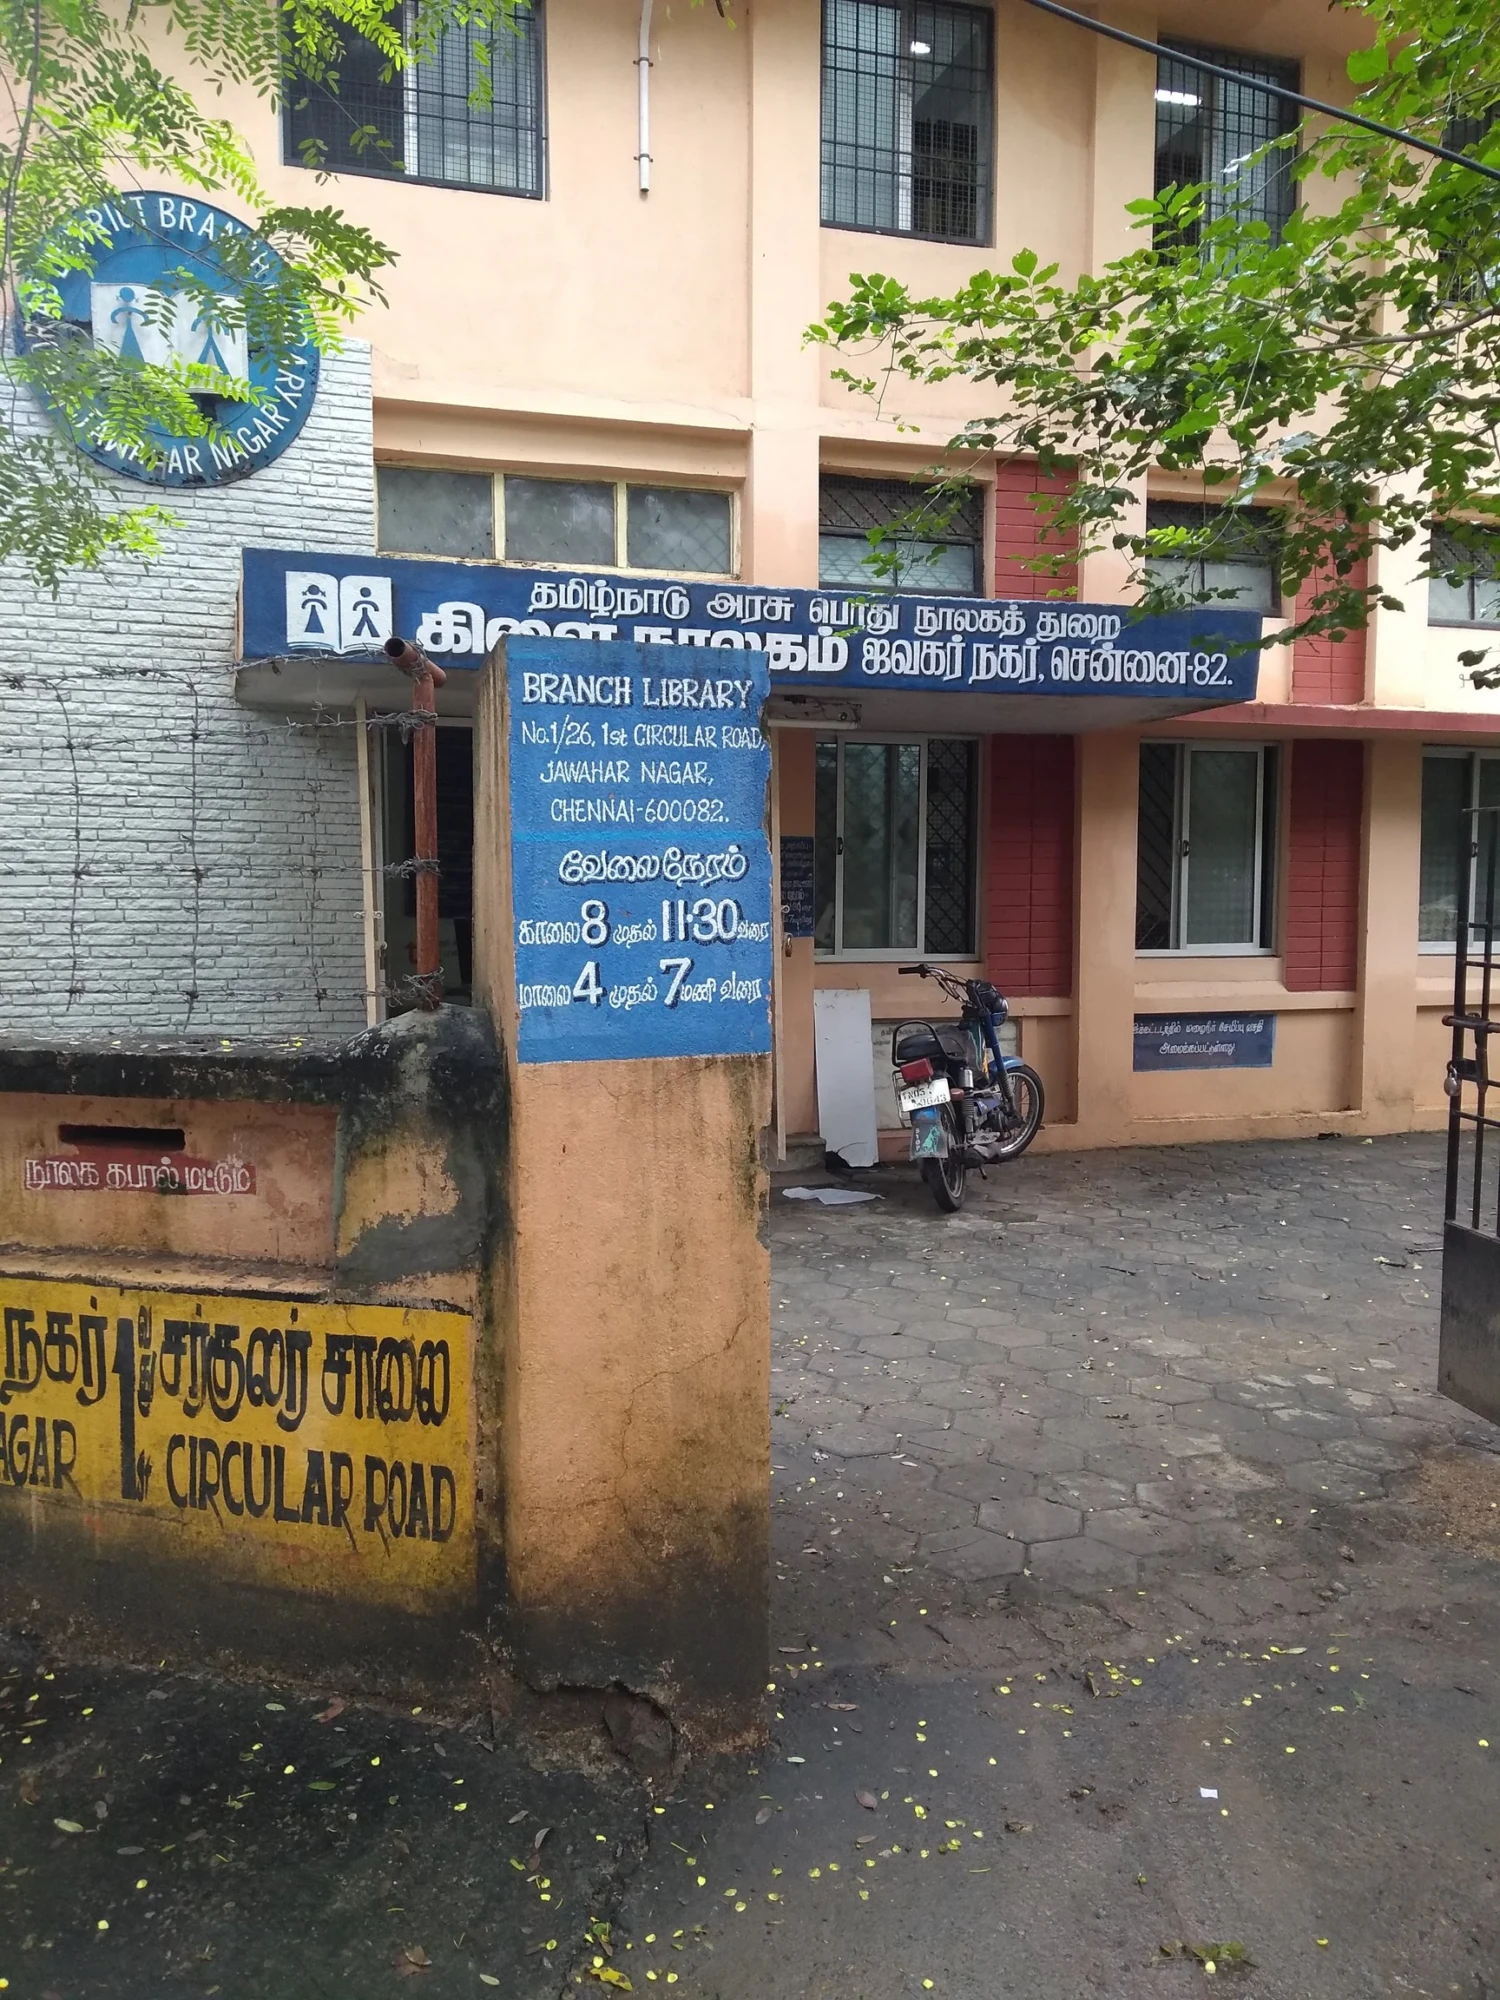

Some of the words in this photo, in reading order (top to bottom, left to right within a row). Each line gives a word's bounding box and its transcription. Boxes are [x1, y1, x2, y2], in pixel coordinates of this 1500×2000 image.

[209, 403, 291, 471] NAGAR
[528, 577, 691, 620] தமிழ்நாடு
[706, 592, 796, 625] அரசு
[808, 598, 901, 637] பொது
[915, 604, 1026, 639] நூலகத்
[1037, 610, 1122, 645] துறை
[862, 635, 964, 681] ஜவகர்
[969, 637, 1045, 684] நகர்,
[522, 672, 631, 705] BRANCH
[643, 677, 754, 708] LIBRARY
[601, 721, 628, 746] 1st
[633, 723, 717, 748] CIRCULAR
[721, 726, 766, 751] ROAD,
[540, 760, 630, 784] JAWAHAR
[640, 760, 714, 786] NAGAR,
[518, 919, 581, 946] காலை
[581, 899, 609, 946] 8
[612, 918, 658, 949] முதல்
[737, 919, 770, 942] வரை
[518, 983, 572, 1009] மாலை
[572, 960, 605, 1005] 4
[609, 976, 659, 1010] முதல்
[659, 957, 693, 1005] 7
[681, 978, 717, 1004] மணி
[720, 970, 763, 1004] வரை
[106, 1156, 179, 1189] தபால்
[0, 1295, 108, 1407] நகர்
[321, 1332, 451, 1426] சாலை
[166, 1432, 359, 1553] CIRCULAR
[364, 1454, 457, 1558] ROAD
